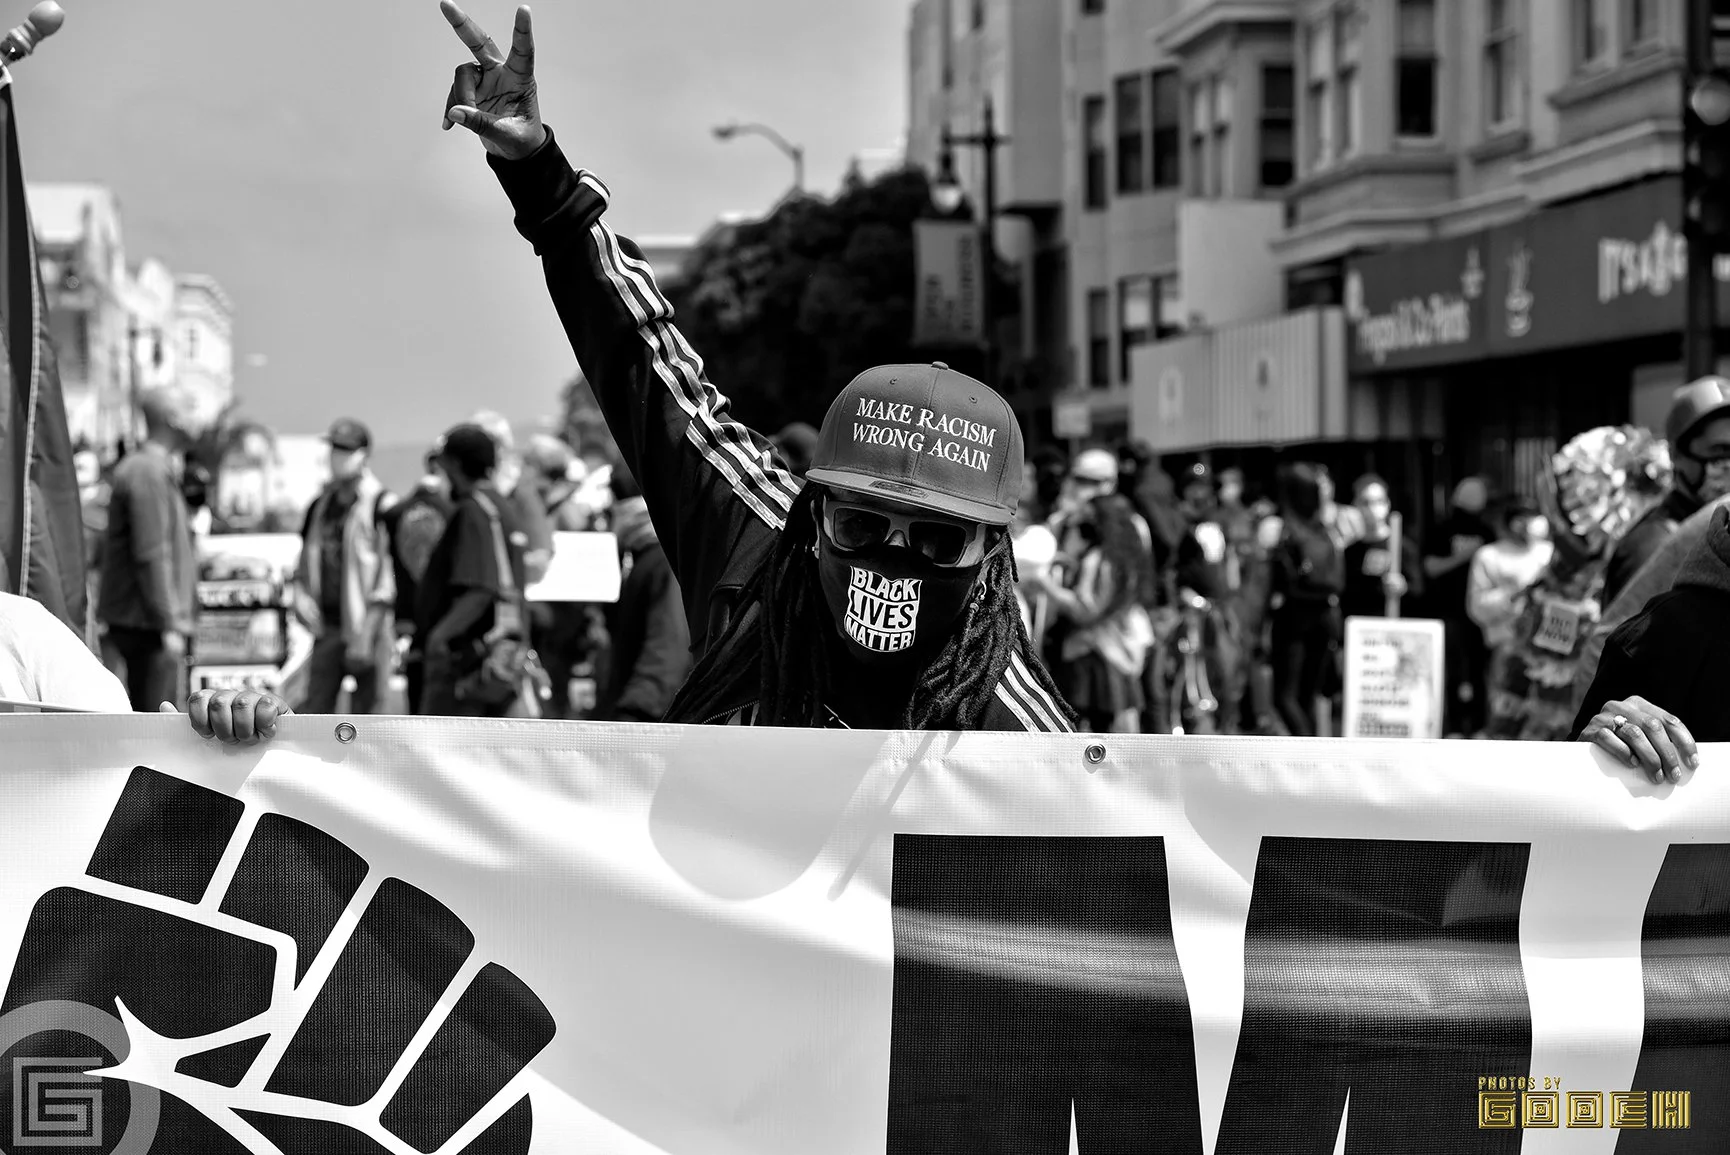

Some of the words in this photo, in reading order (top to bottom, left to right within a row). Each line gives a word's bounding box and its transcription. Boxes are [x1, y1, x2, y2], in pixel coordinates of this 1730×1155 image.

[856, 397, 913, 424] MAKE
[917, 408, 997, 448] RACISM
[852, 422, 925, 452] WRONG
[928, 437, 992, 472] AGAIN
[852, 567, 920, 601] BLACK
[849, 588, 914, 629] LIVES
[846, 618, 913, 651] MATTER
